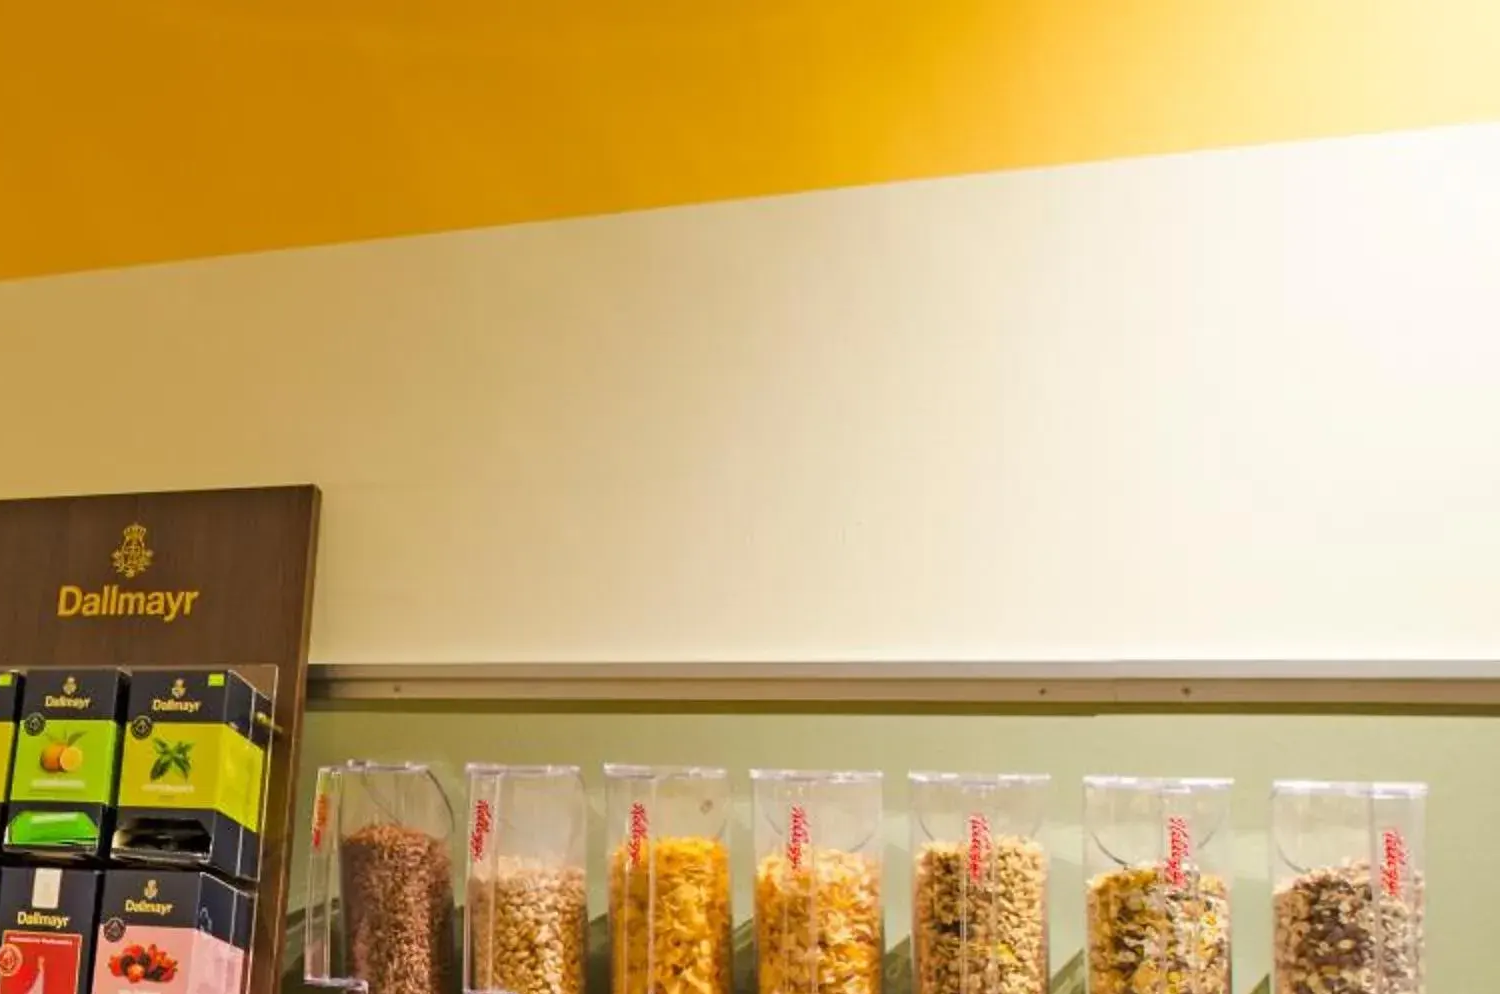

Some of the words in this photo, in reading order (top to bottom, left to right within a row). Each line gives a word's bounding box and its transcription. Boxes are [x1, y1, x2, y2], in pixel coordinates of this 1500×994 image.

[57, 584, 198, 622] Dallmayr
[45, 695, 91, 711] Dallmayr
[152, 698, 201, 714] Dallmayr
[125, 899, 174, 916] Dallmayr
[17, 910, 70, 928] Dallmayr
